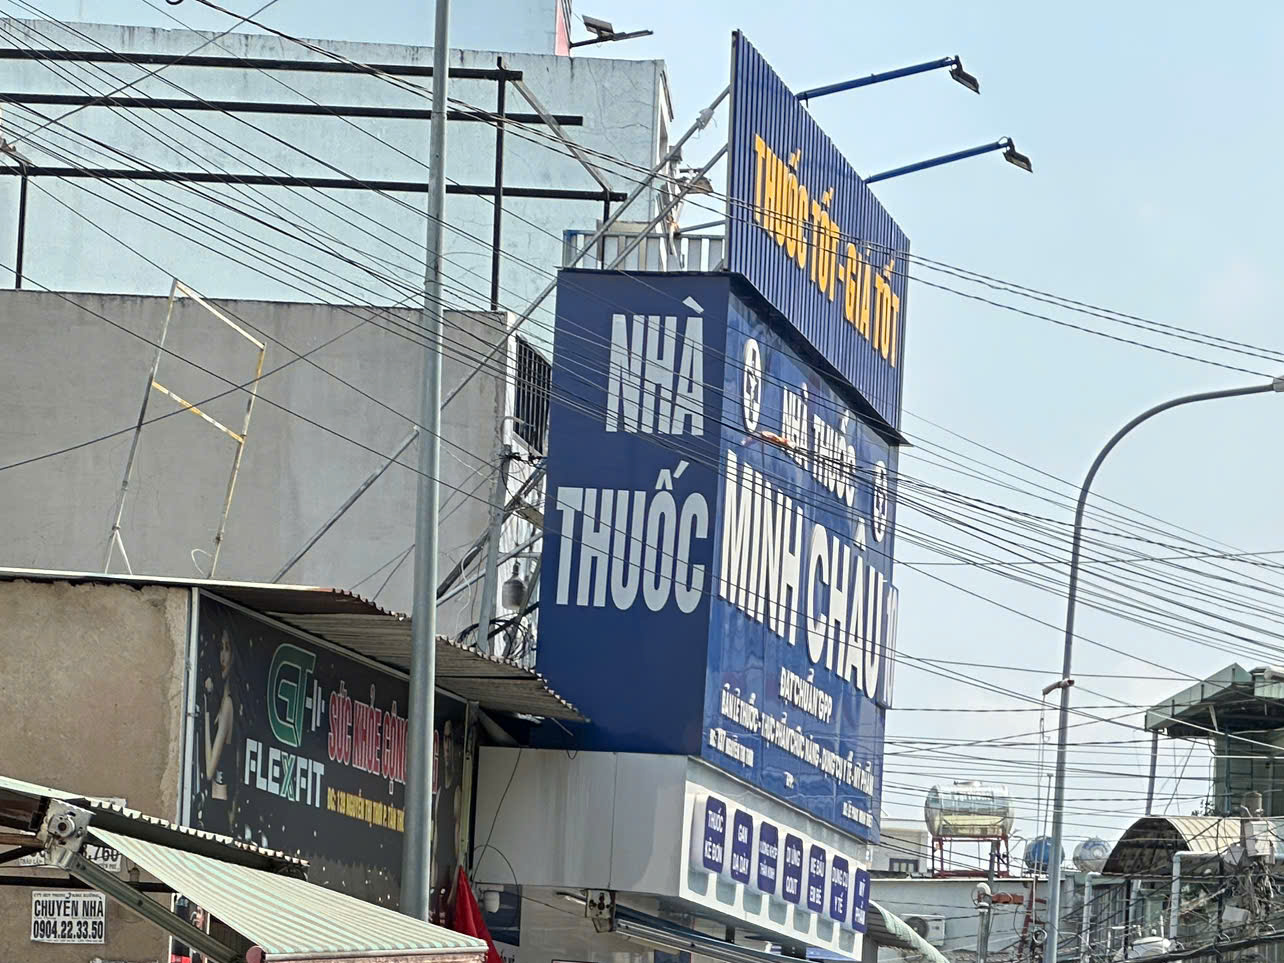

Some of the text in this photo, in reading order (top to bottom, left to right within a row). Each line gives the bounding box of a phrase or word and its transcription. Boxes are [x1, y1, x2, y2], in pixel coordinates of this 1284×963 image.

[754, 134, 807, 270] THUỐC
[873, 259, 900, 368] TỐT
[606, 296, 704, 437] NHÀ
[813, 409, 856, 505] THUỐC
[556, 460, 709, 614] THUỐC
[719, 449, 803, 647] MINH
[806, 517, 884, 699] CHÂU
[244, 738, 325, 808] FLEXFIT
[327, 680, 353, 766] SỨC
[33, 920, 104, 940] 0904.22.33.50
